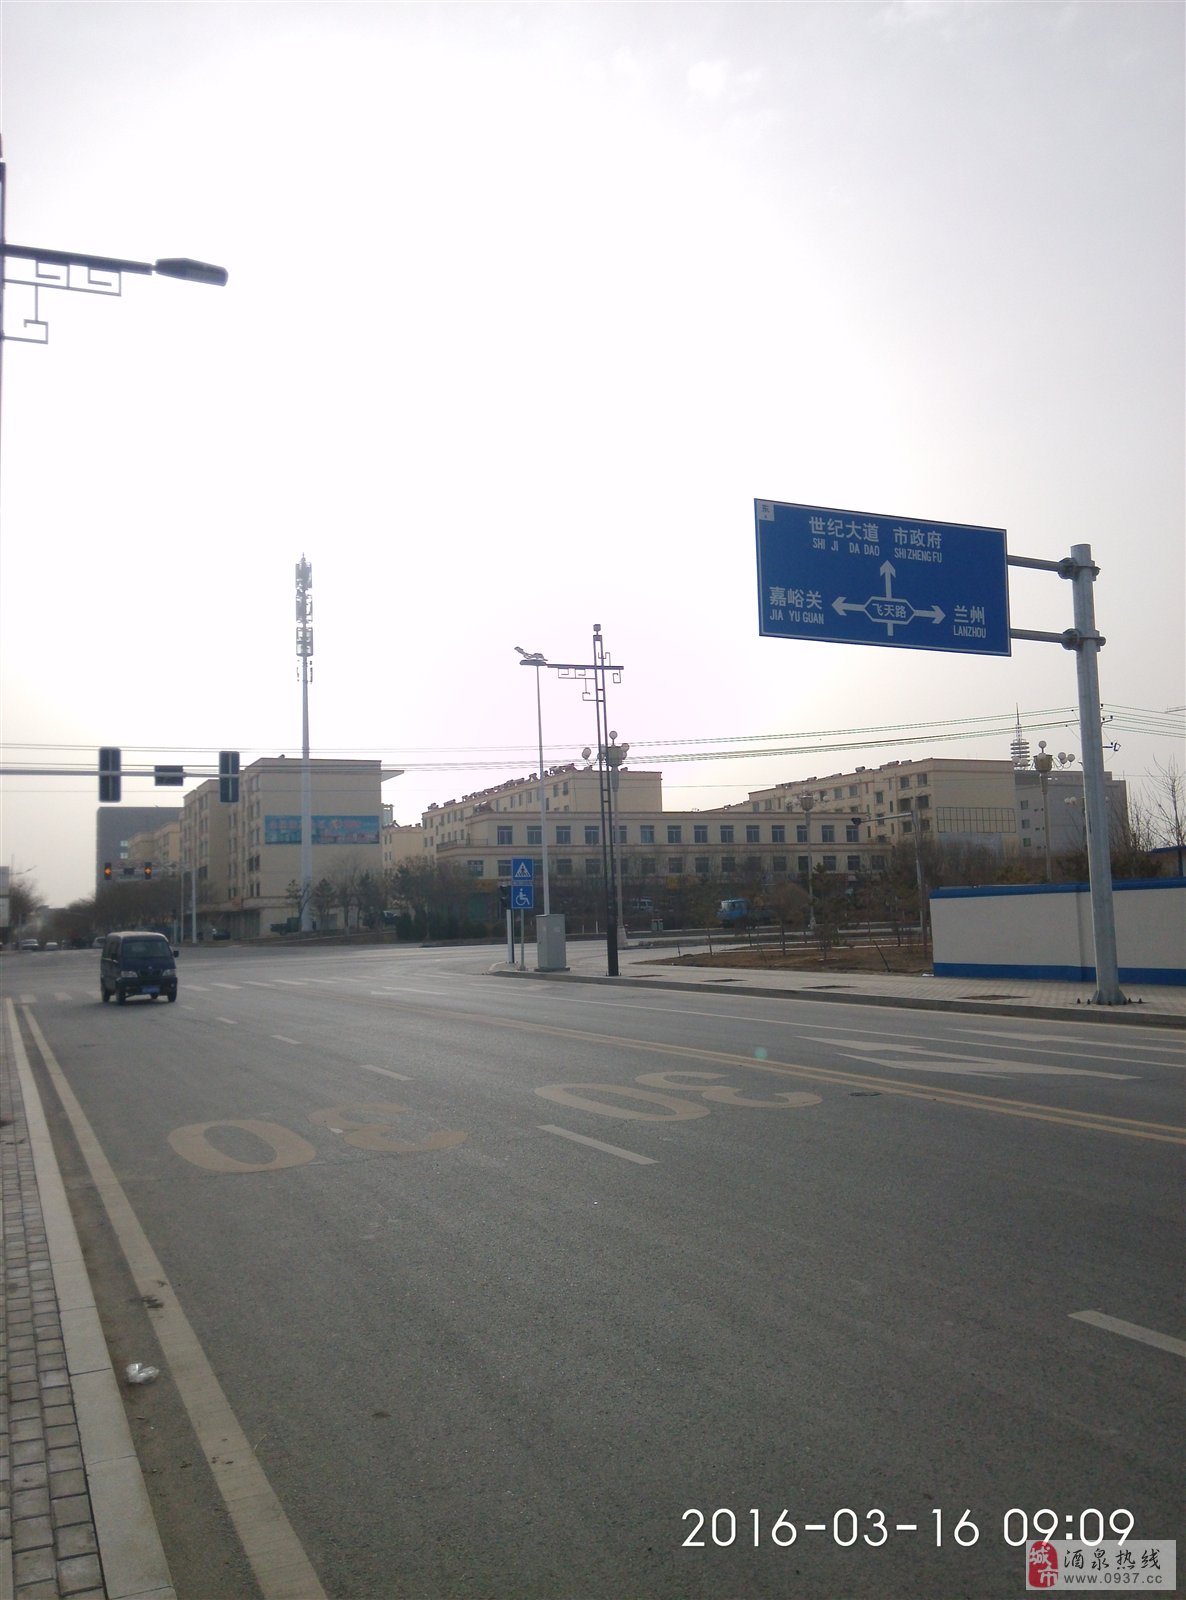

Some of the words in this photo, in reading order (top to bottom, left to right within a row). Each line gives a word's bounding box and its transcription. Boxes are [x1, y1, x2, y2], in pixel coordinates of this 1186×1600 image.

[809, 516, 879, 542] 世纪大道
[893, 527, 942, 549] 市政府
[812, 538, 826, 550] SHI
[831, 540, 839, 551] JI
[850, 542, 860, 554] DA
[864, 544, 880, 556] DAO
[769, 586, 823, 610] 嘉峪关
[769, 609, 784, 621] JIA
[788, 610, 801, 622] YU
[802, 611, 825, 625] GUAN
[872, 603, 907, 618] 飞天路
[954, 605, 985, 625] 兰州
[953, 625, 987, 639] LANZHOU
